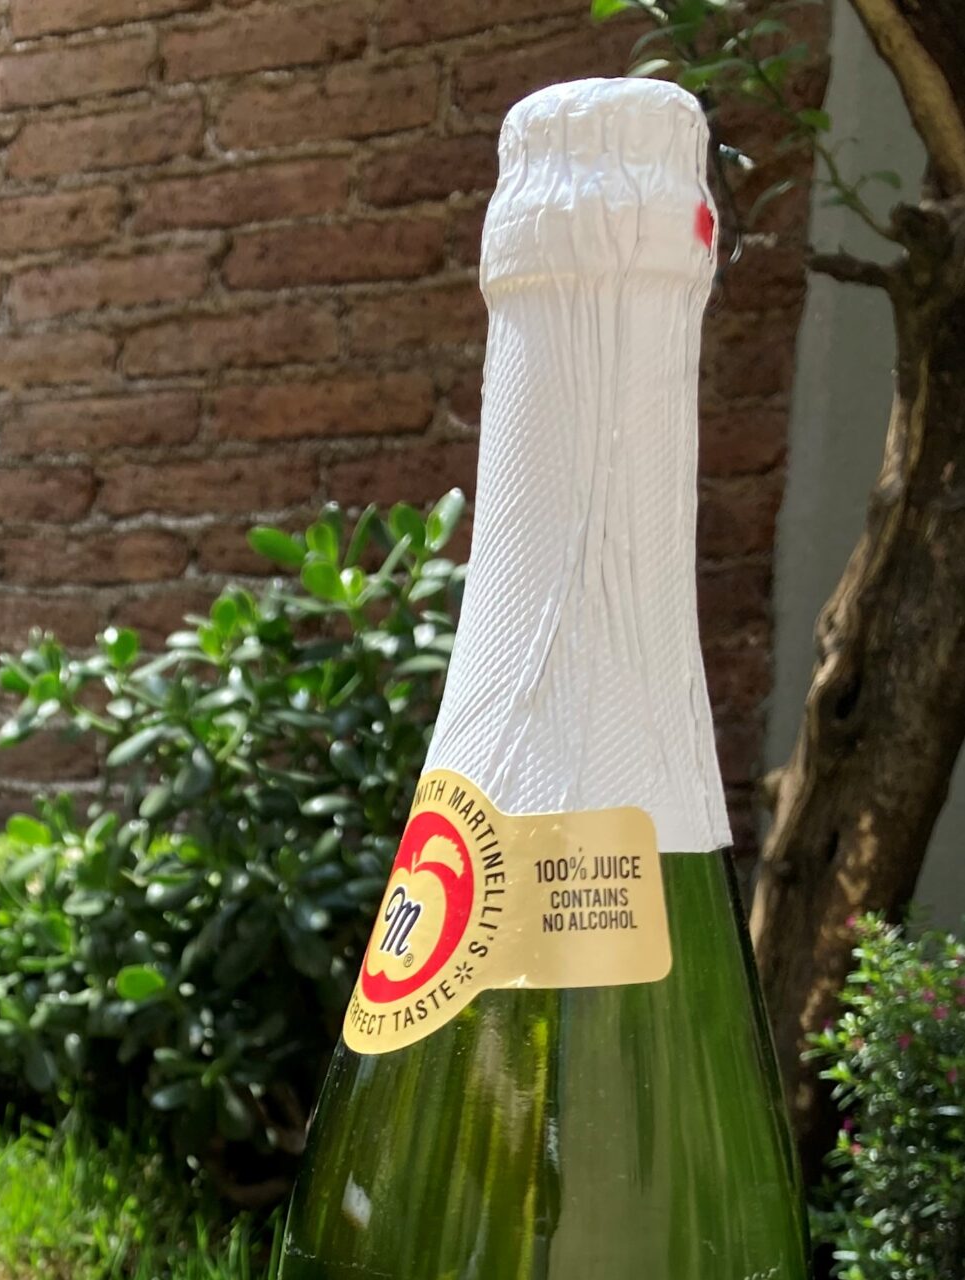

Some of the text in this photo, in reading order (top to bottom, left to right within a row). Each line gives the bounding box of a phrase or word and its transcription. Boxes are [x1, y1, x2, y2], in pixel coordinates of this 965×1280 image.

[447, 786, 506, 959] MARTINELLI'S
[534, 856, 641, 883] 100% JUICE
[550, 888, 628, 909] CONTAINS
[542, 910, 638, 932] NO ALCOHOL
[392, 980, 455, 1032] TASTE
